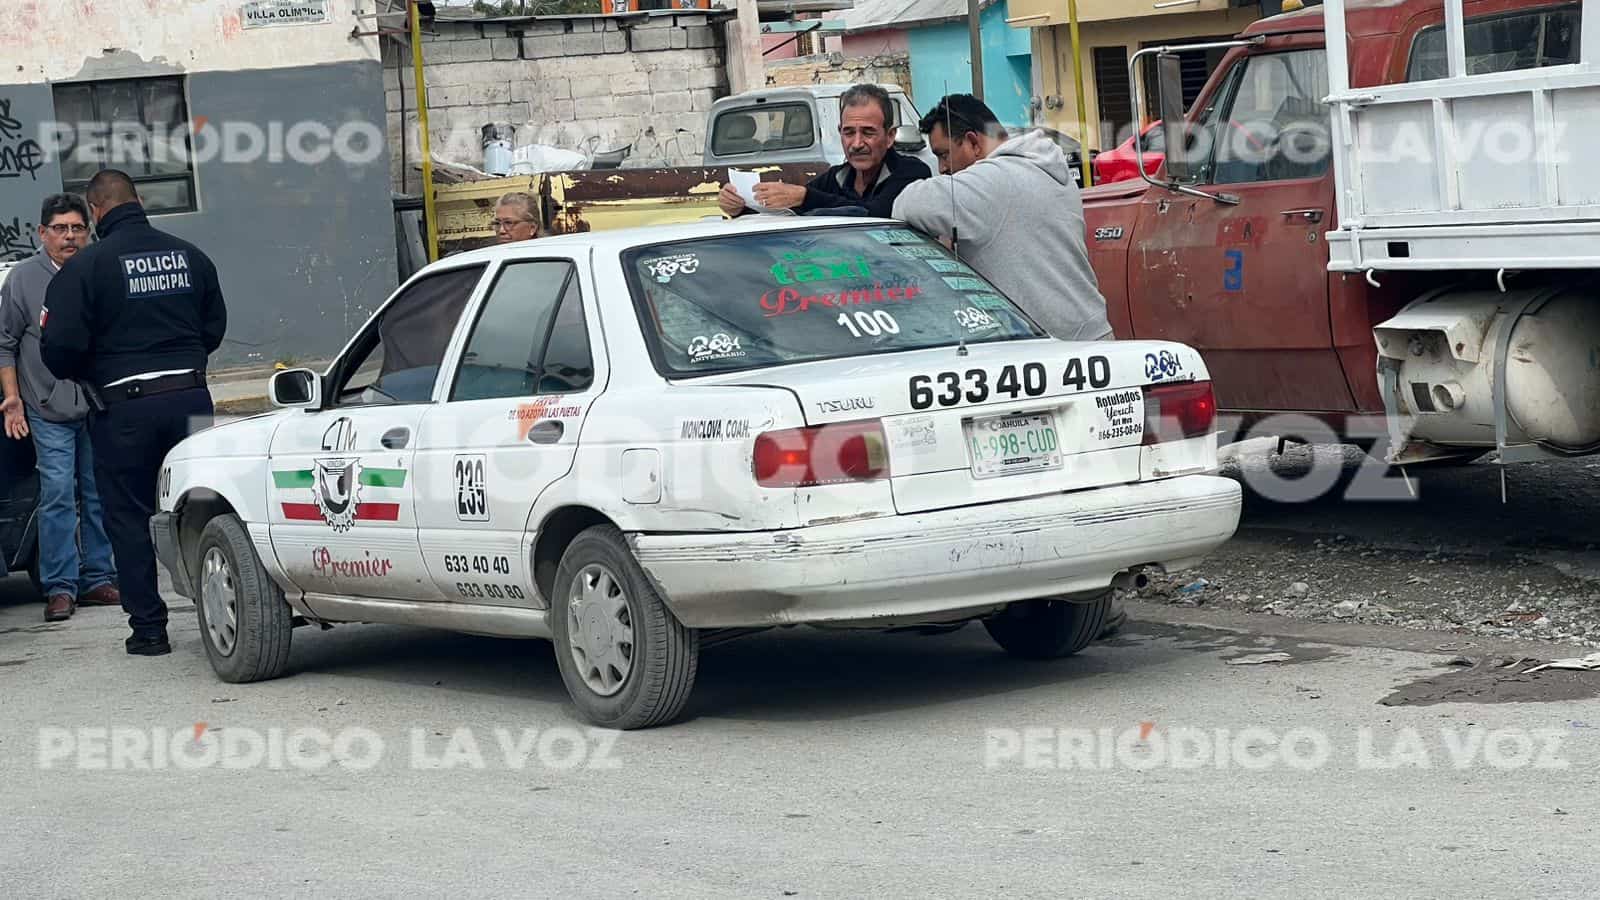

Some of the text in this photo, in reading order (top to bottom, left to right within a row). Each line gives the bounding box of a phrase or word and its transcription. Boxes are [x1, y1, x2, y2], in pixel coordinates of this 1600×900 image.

[1094, 226, 1124, 240] 350
[124, 251, 188, 275] POLICÍA
[769, 255, 872, 285] taxi
[128, 272, 191, 294] MUNICIPAL
[759, 286, 924, 318] Premier
[837, 310, 900, 338] 100
[909, 368, 990, 410] 633
[996, 361, 1047, 399] 40
[1062, 355, 1111, 391] 40
[815, 396, 876, 414] TSURU
[1095, 391, 1141, 409] Rotulados
[680, 419, 751, 441] MONCLOVA, COAH.
[990, 418, 1030, 432] COAHUILA
[972, 427, 1058, 460] A-998-CUD
[312, 546, 394, 578] Premier
[444, 555, 510, 575] 633 40 40
[456, 582, 525, 600] 633 80 80
